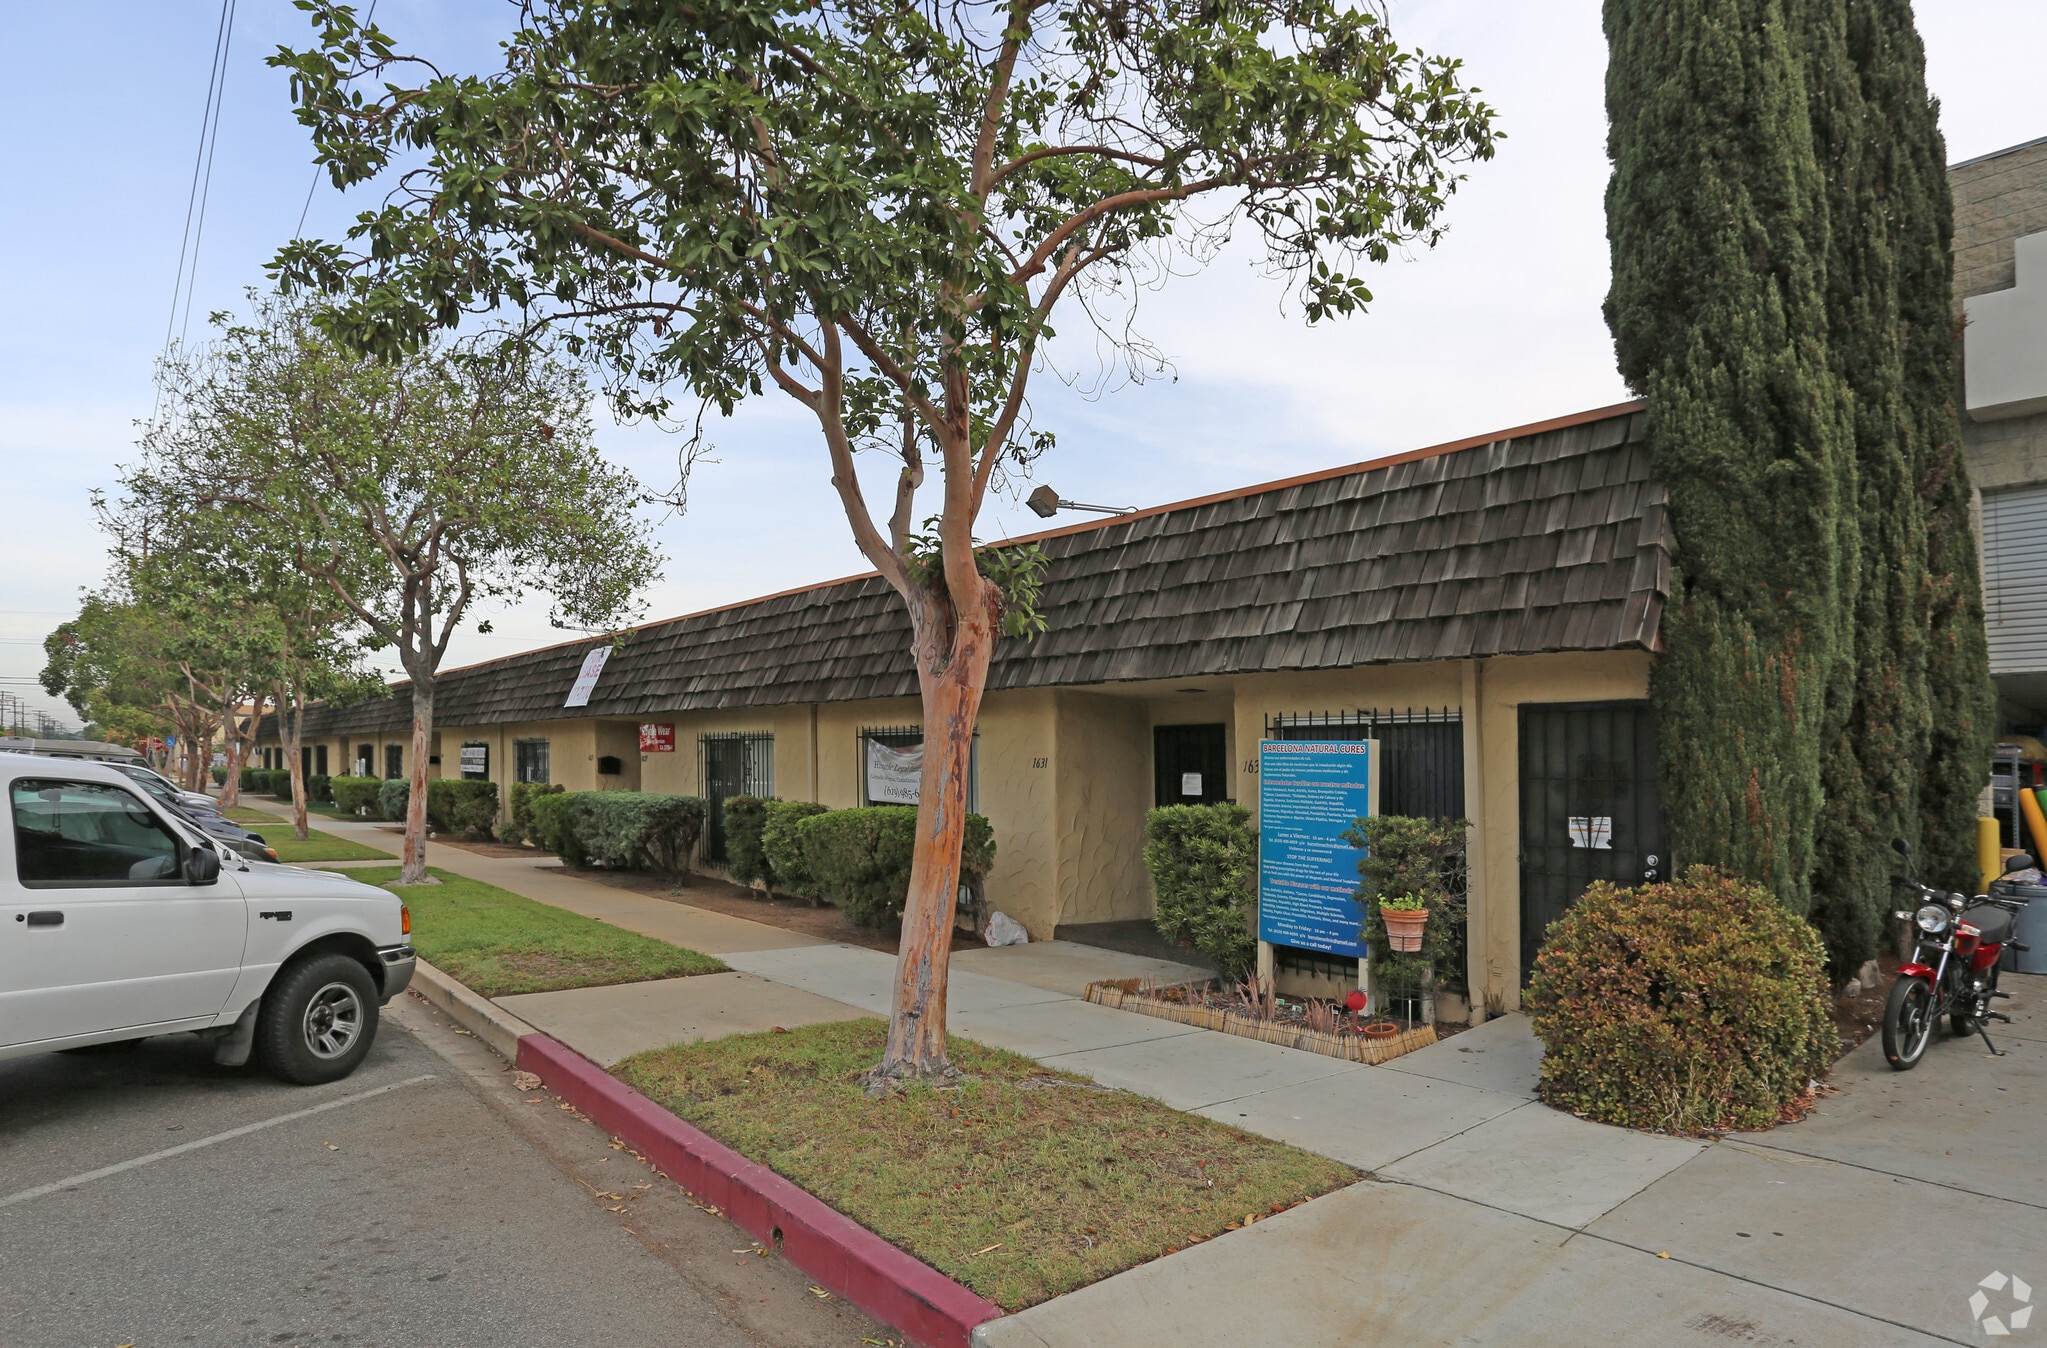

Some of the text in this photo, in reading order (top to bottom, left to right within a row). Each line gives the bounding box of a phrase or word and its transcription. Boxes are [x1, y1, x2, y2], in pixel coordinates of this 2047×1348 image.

[1263, 744, 1366, 754] BARCELONA NATURAL CURES
[1032, 757, 1048, 769] 1631
[884, 785, 899, 798] (619)
